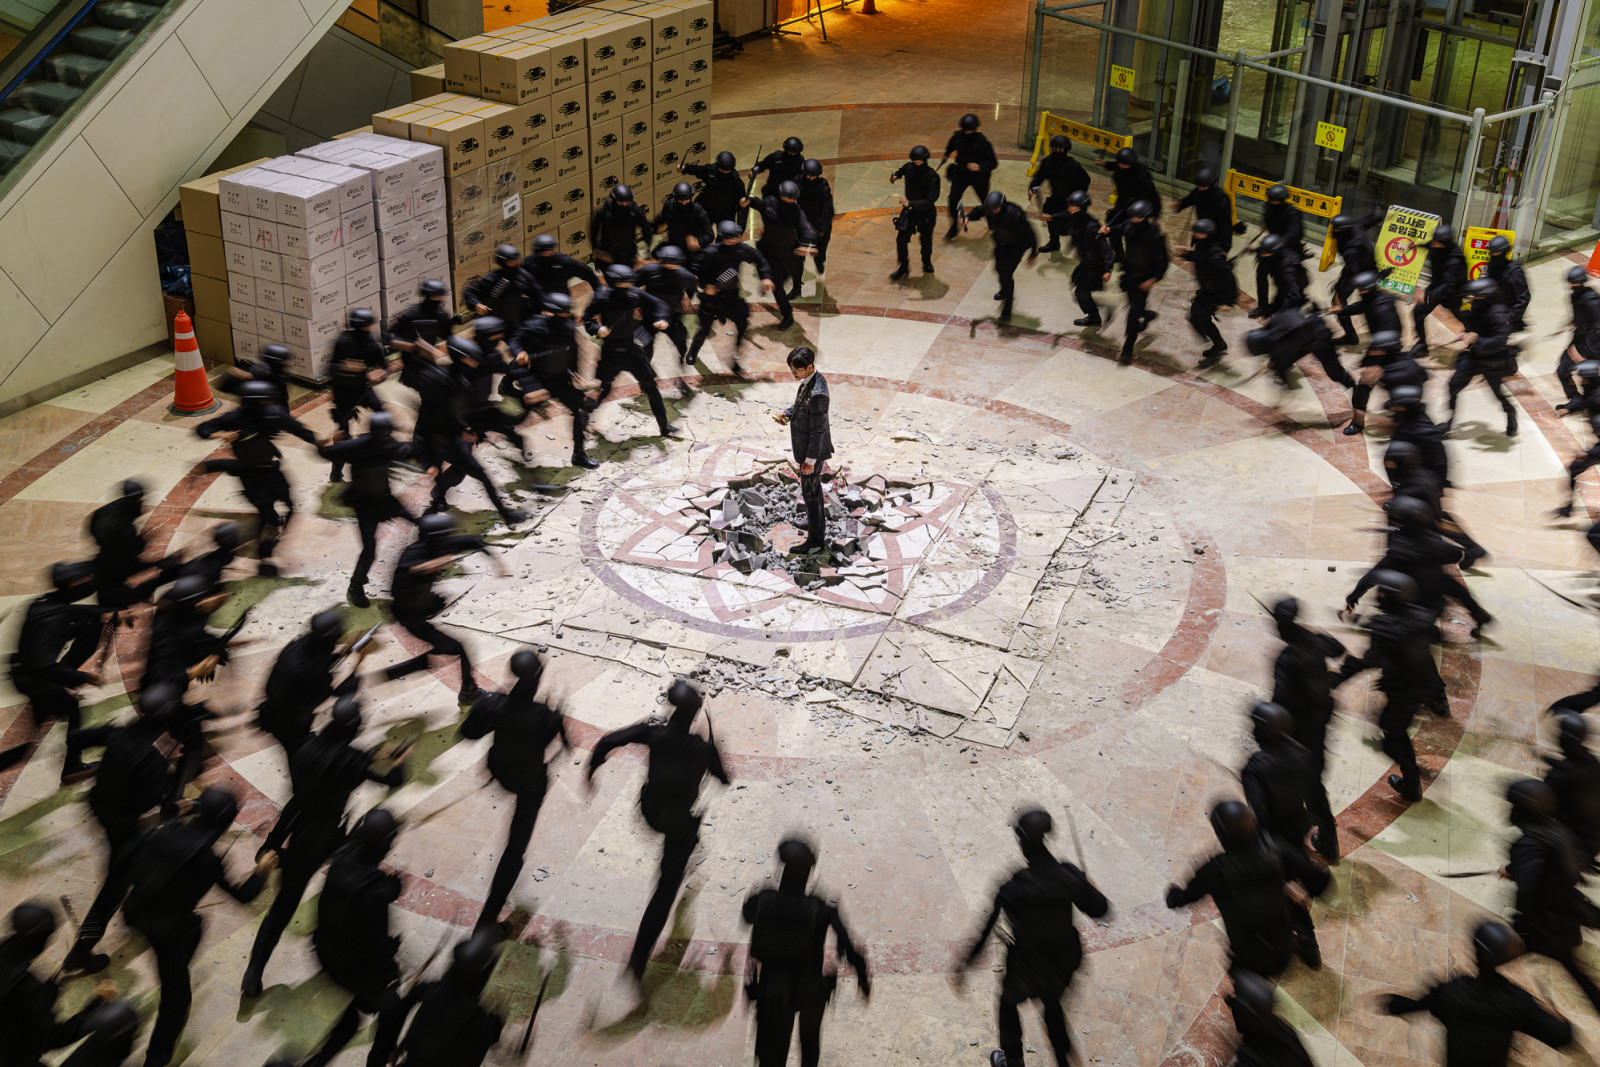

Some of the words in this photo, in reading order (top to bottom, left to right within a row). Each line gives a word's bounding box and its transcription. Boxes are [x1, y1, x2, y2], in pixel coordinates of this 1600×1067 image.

[1292, 195, 1314, 207] 제일
[1396, 214, 1426, 229] 공사중
[1388, 223, 1428, 240] 출입금지
[1396, 283, 1412, 293] 제일
